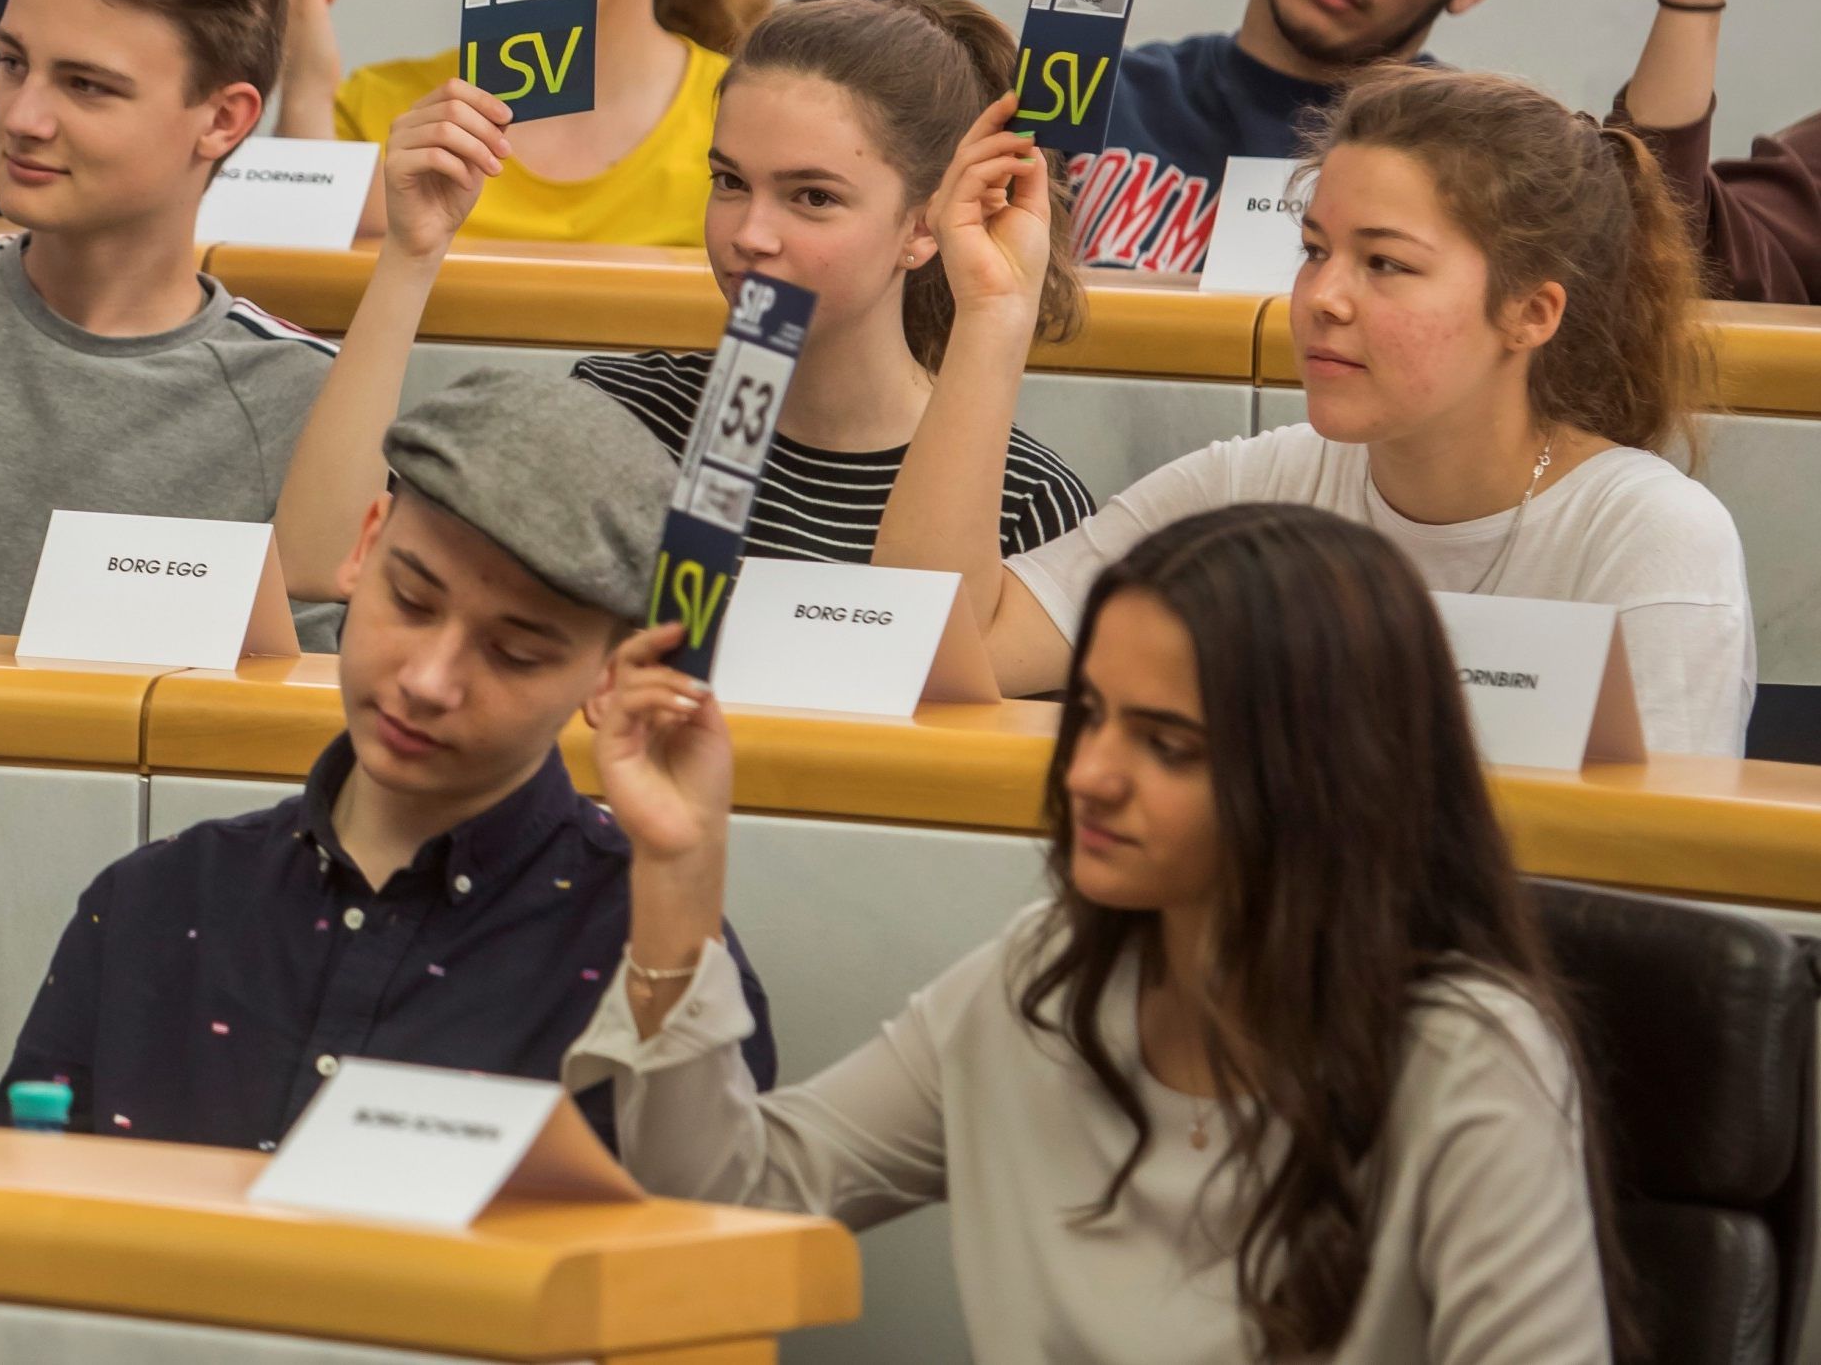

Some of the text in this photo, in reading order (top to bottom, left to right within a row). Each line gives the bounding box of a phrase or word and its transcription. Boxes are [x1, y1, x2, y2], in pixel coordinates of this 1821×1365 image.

[467, 26, 583, 101] LSV
[1015, 47, 1110, 126] LSV
[246, 169, 334, 184] DORNBIRN
[1068, 147, 1222, 274] OMM
[1247, 197, 1271, 212] BG
[721, 374, 773, 446] 53
[107, 556, 208, 578] BORG EGG
[794, 604, 893, 626] BORG EGG
